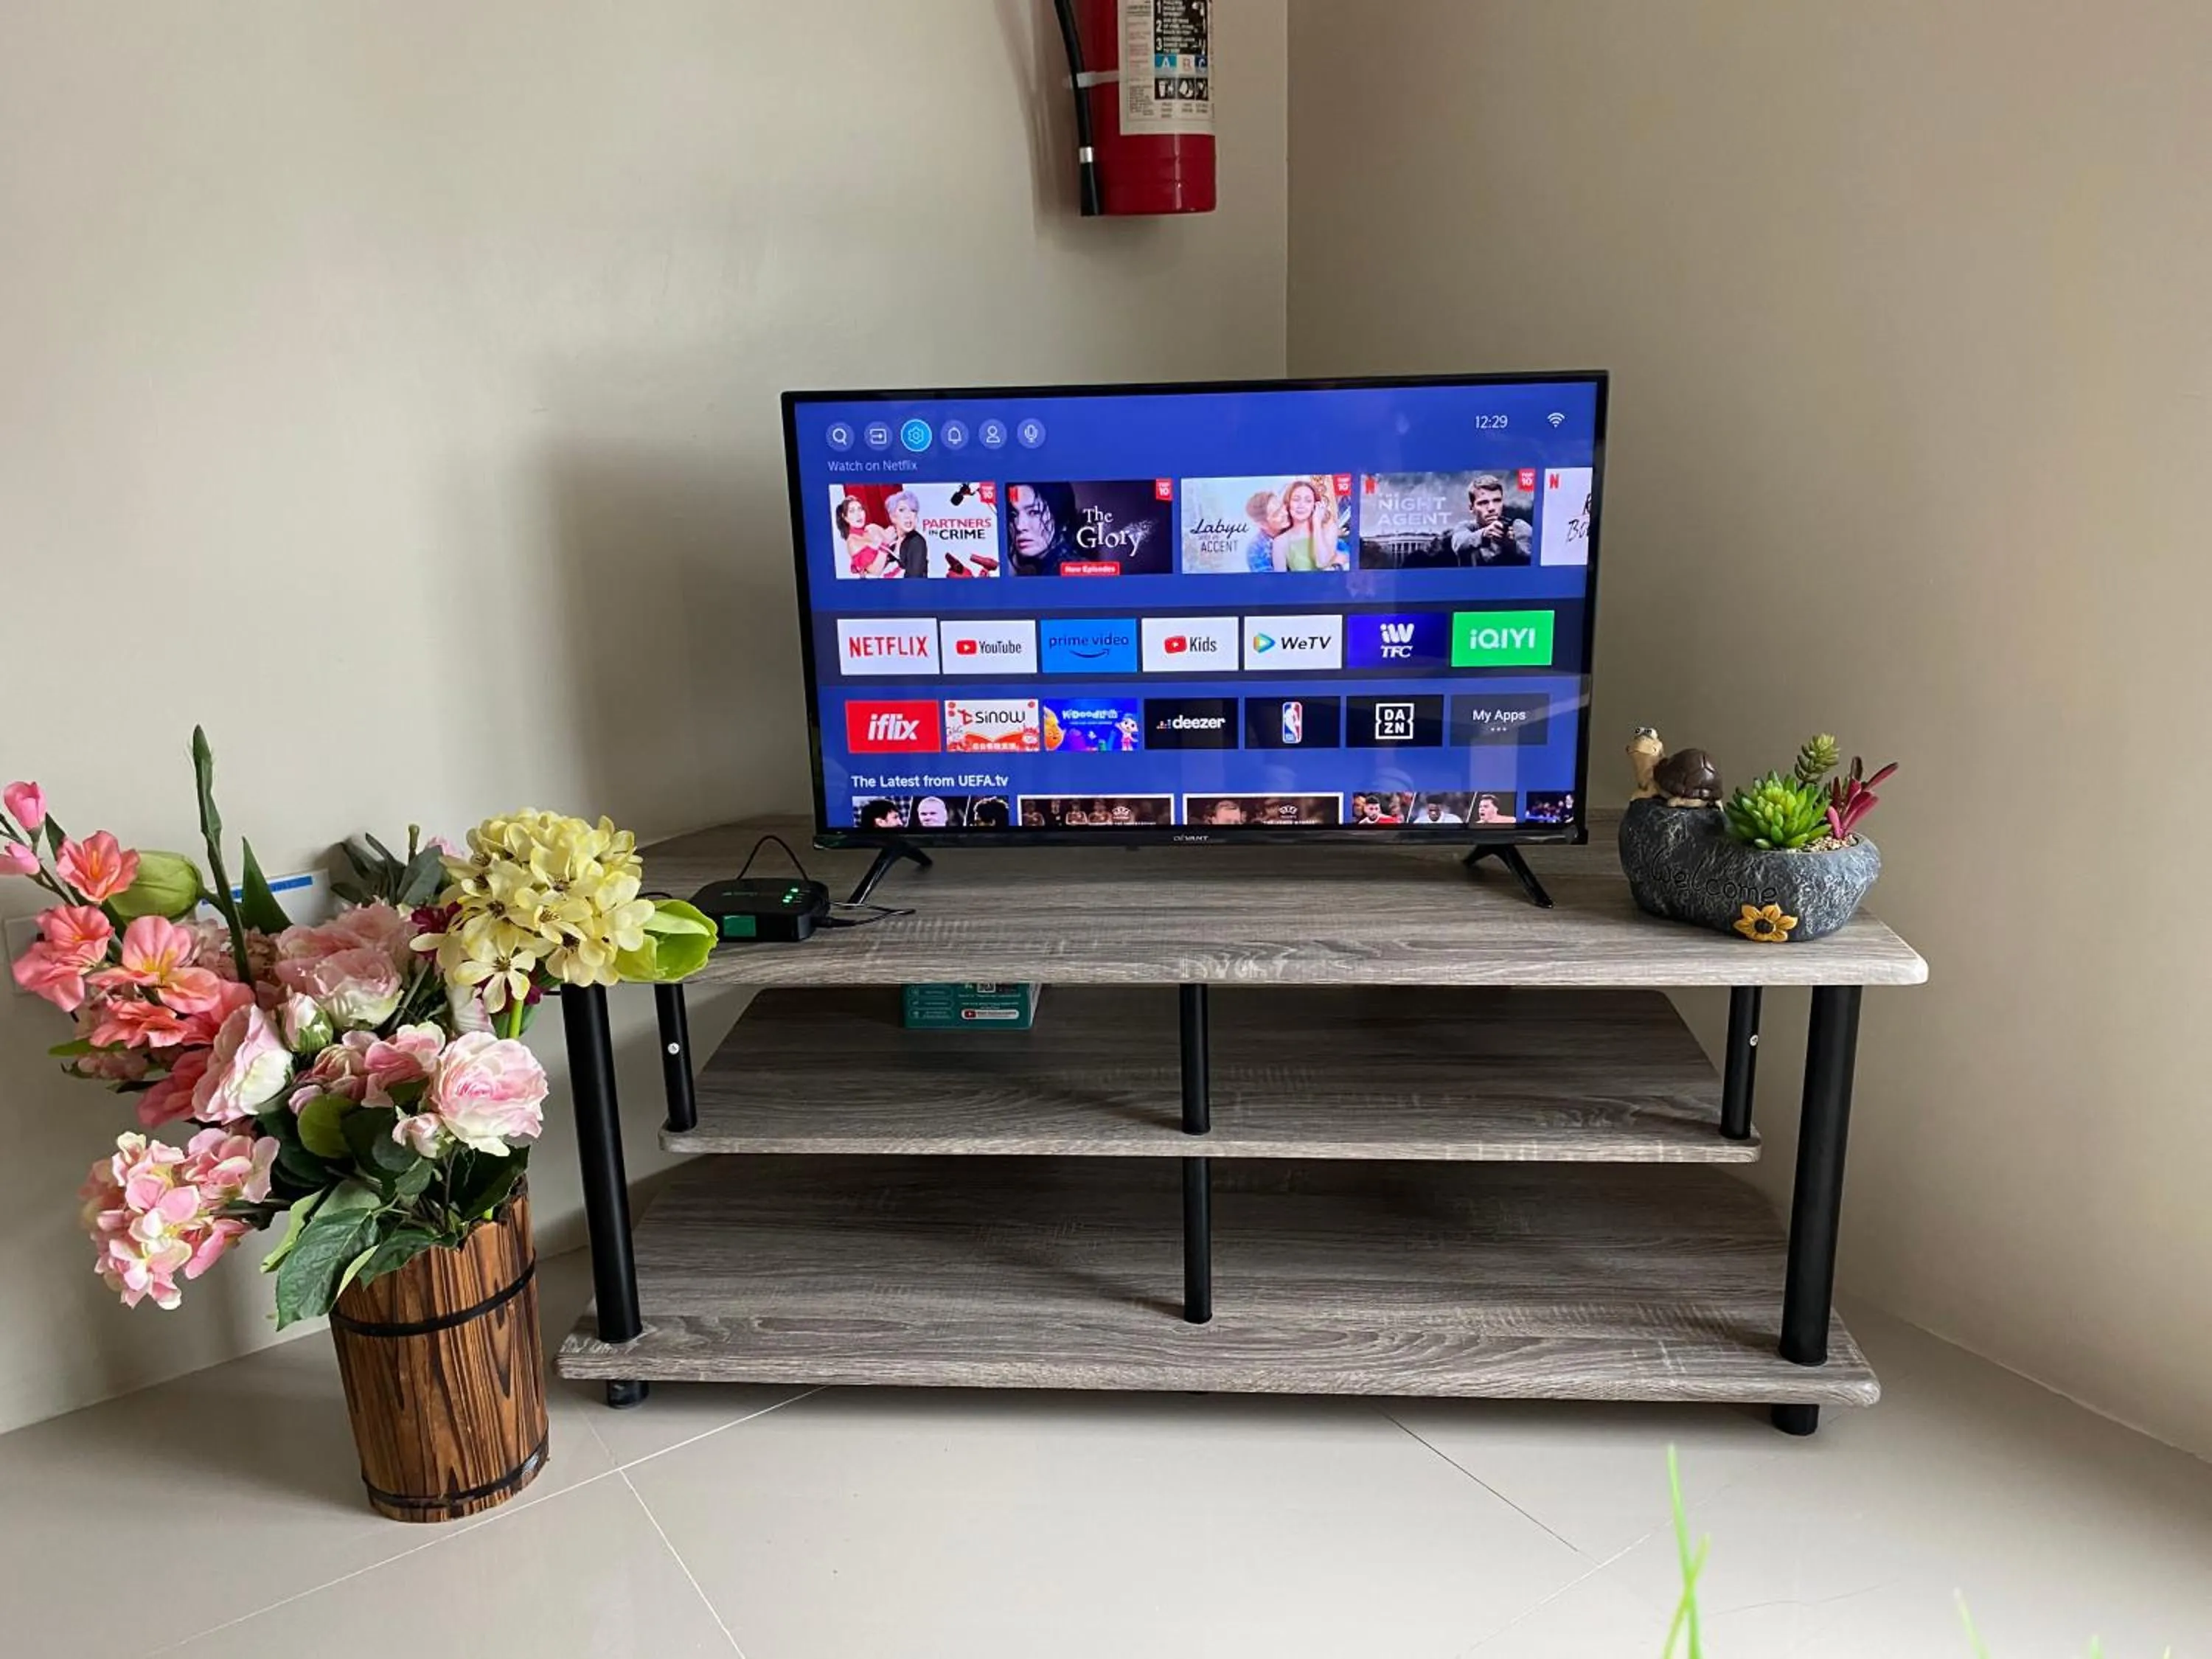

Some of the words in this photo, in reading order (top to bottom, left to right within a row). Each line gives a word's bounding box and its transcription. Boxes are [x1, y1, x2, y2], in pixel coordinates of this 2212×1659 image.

[1155, 19, 1163, 32] 2
[1155, 37, 1163, 51] 3
[1162, 56, 1171, 68] A
[1475, 414, 1508, 429] 12:29
[827, 460, 863, 471] Watch
[865, 462, 880, 471] on
[883, 459, 918, 471] Netflix
[1550, 473, 1559, 489] N
[1378, 496, 1446, 511] NIGHT
[1082, 505, 1114, 523] The
[1377, 512, 1452, 525] AGENT
[922, 518, 992, 532] PARTNERS
[1189, 518, 1250, 540] Labyu
[939, 529, 986, 540] CRIME
[1076, 521, 1144, 557] Glory
[1201, 539, 1238, 552] ACCENT
[1048, 636, 1090, 647] prime
[1092, 632, 1130, 646] video
[1189, 636, 1217, 653] Kids
[1281, 636, 1331, 650] WeTV
[849, 636, 929, 658] NETFLIX
[978, 640, 1022, 655] YouTube
[1380, 644, 1413, 658] TFC
[1172, 714, 1226, 729] deezer
[1472, 710, 1491, 723] My
[1494, 710, 1526, 723] Apps
[867, 713, 920, 741] iflix
[851, 776, 876, 787] The
[880, 776, 920, 787] Latest
[923, 775, 955, 787] from
[959, 775, 1009, 787] UEFA.tv
